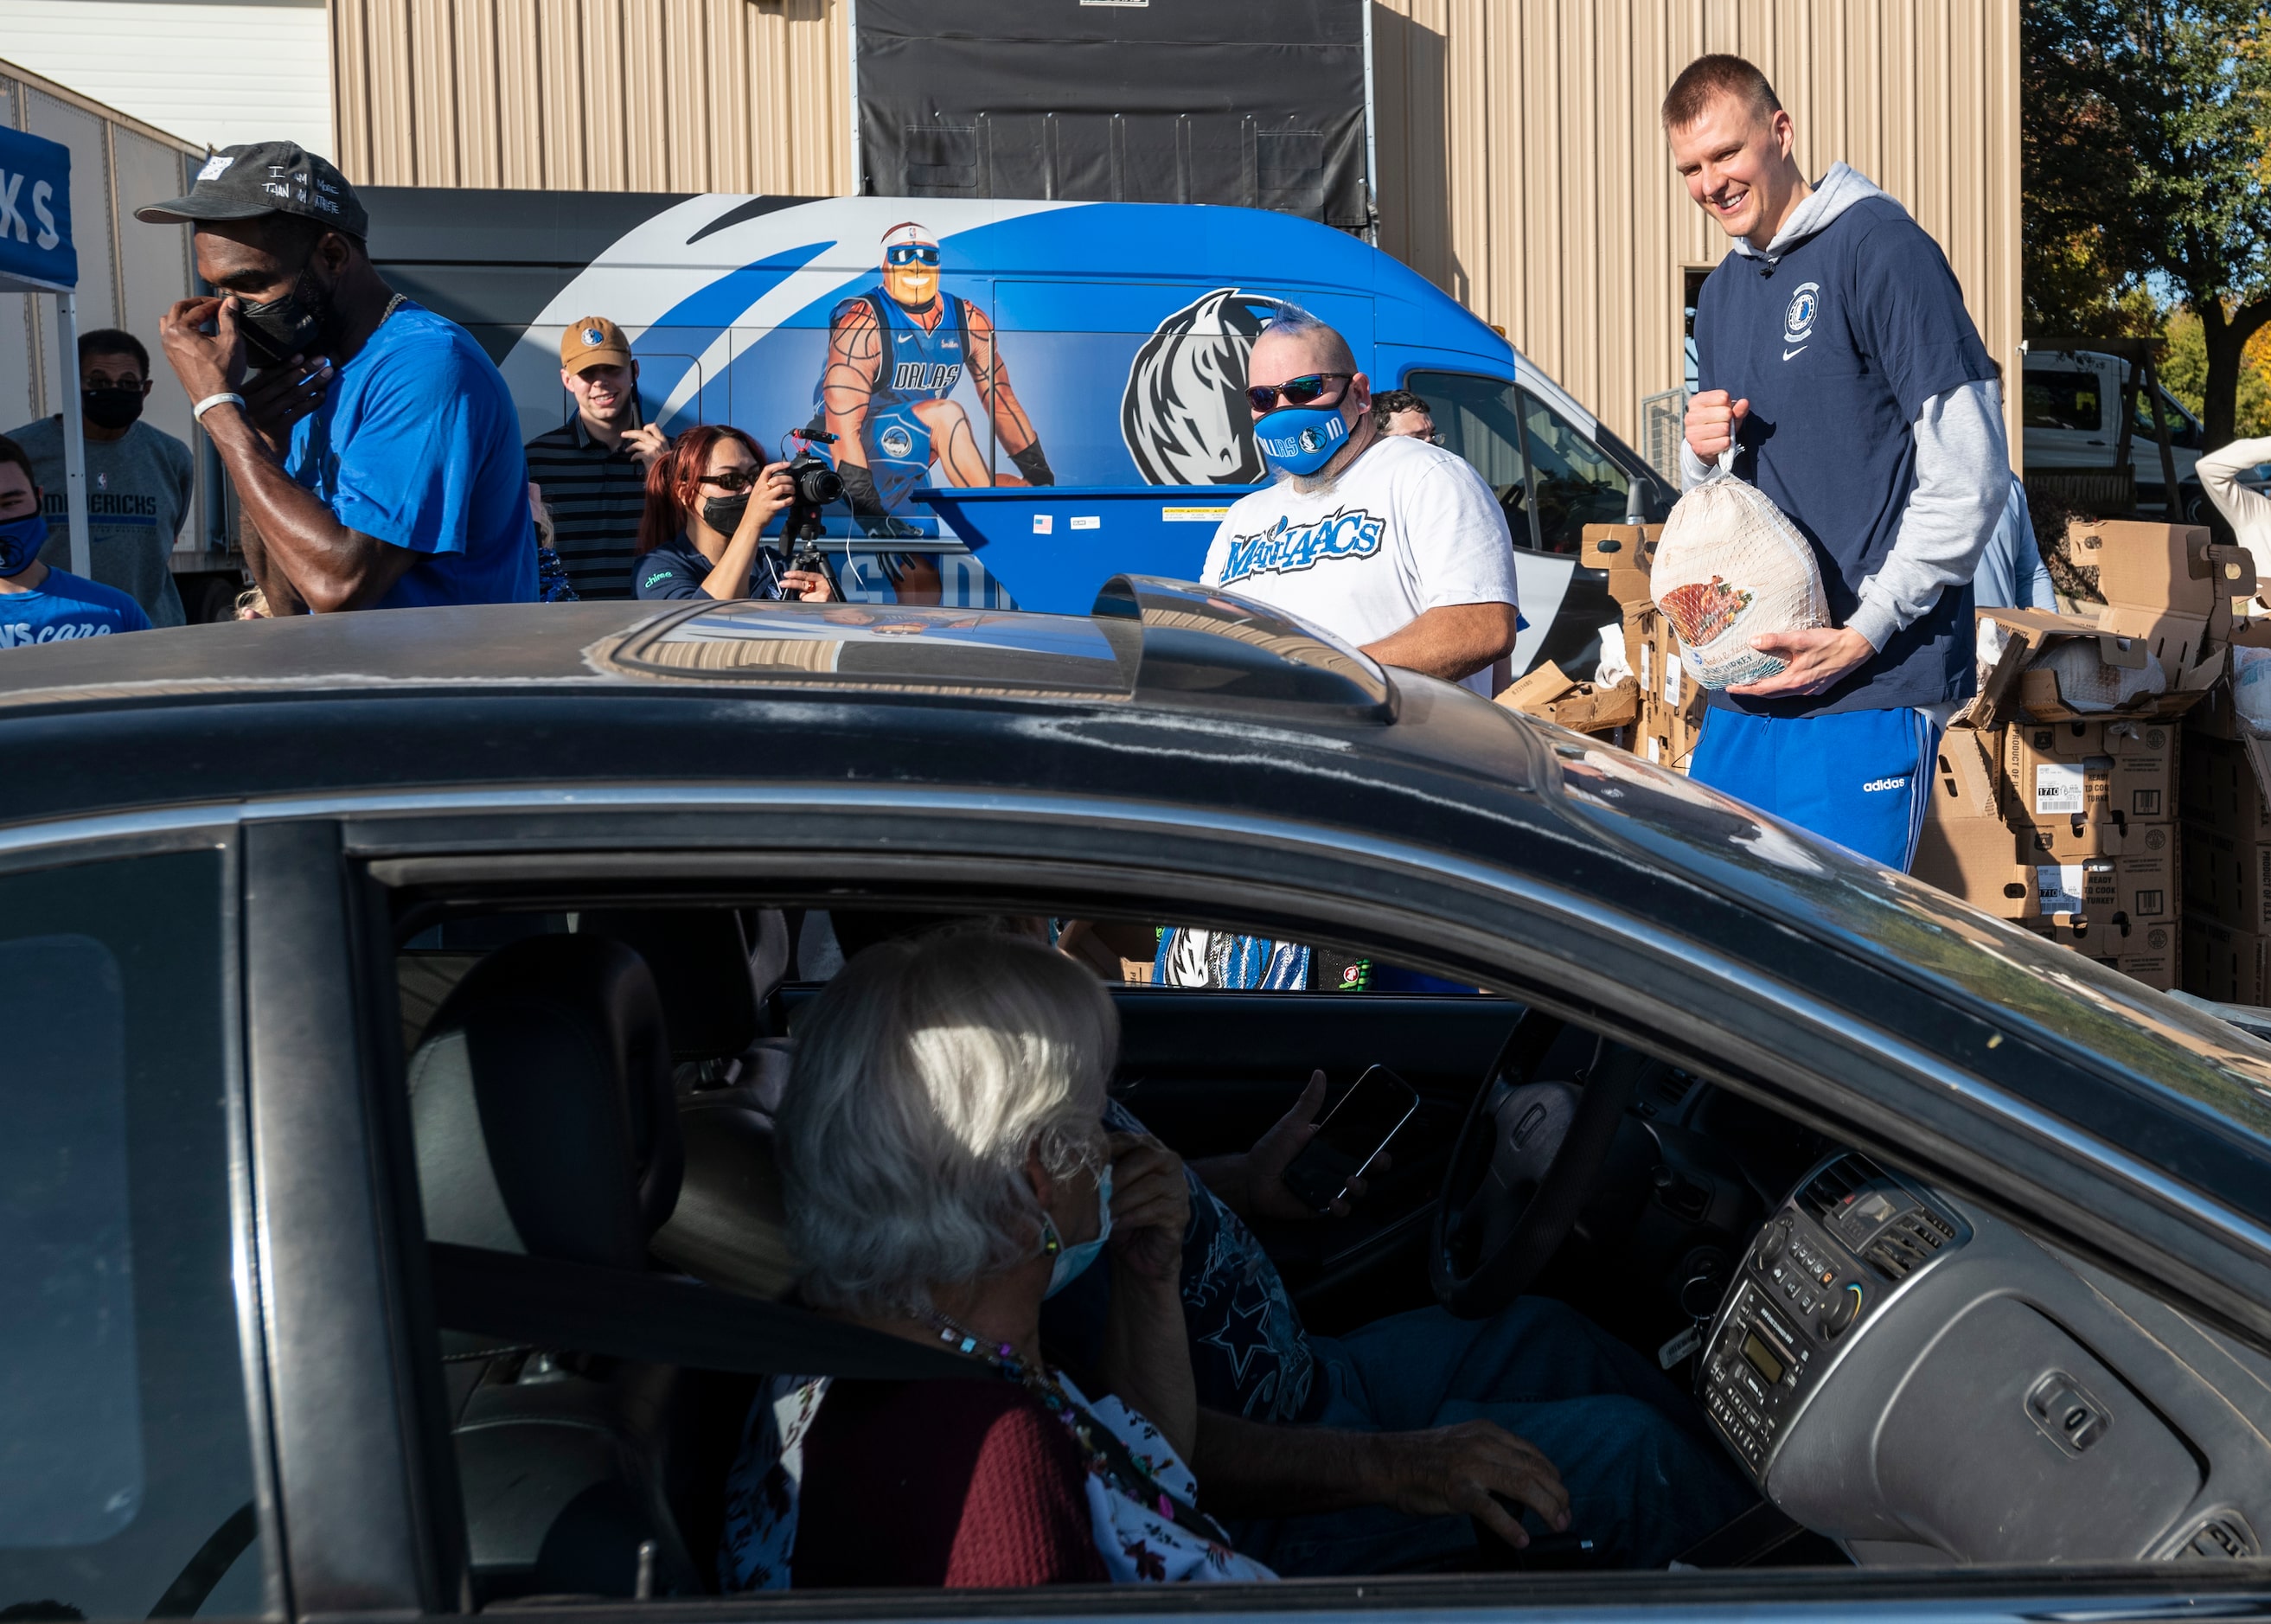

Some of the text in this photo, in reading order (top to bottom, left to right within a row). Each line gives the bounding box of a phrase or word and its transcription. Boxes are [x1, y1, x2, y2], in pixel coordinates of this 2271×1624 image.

[268, 166, 285, 178] I
[261, 182, 290, 199] THAN
[45, 493, 157, 515] MERICKS
[645, 572, 673, 588] chime
[2012, 729, 2020, 767] PRODUCT
[2012, 770, 2019, 780] OF
[2084, 784, 2093, 793] TO
[2262, 851, 2271, 886] PRODUCT
[2263, 890, 2271, 899] OF
